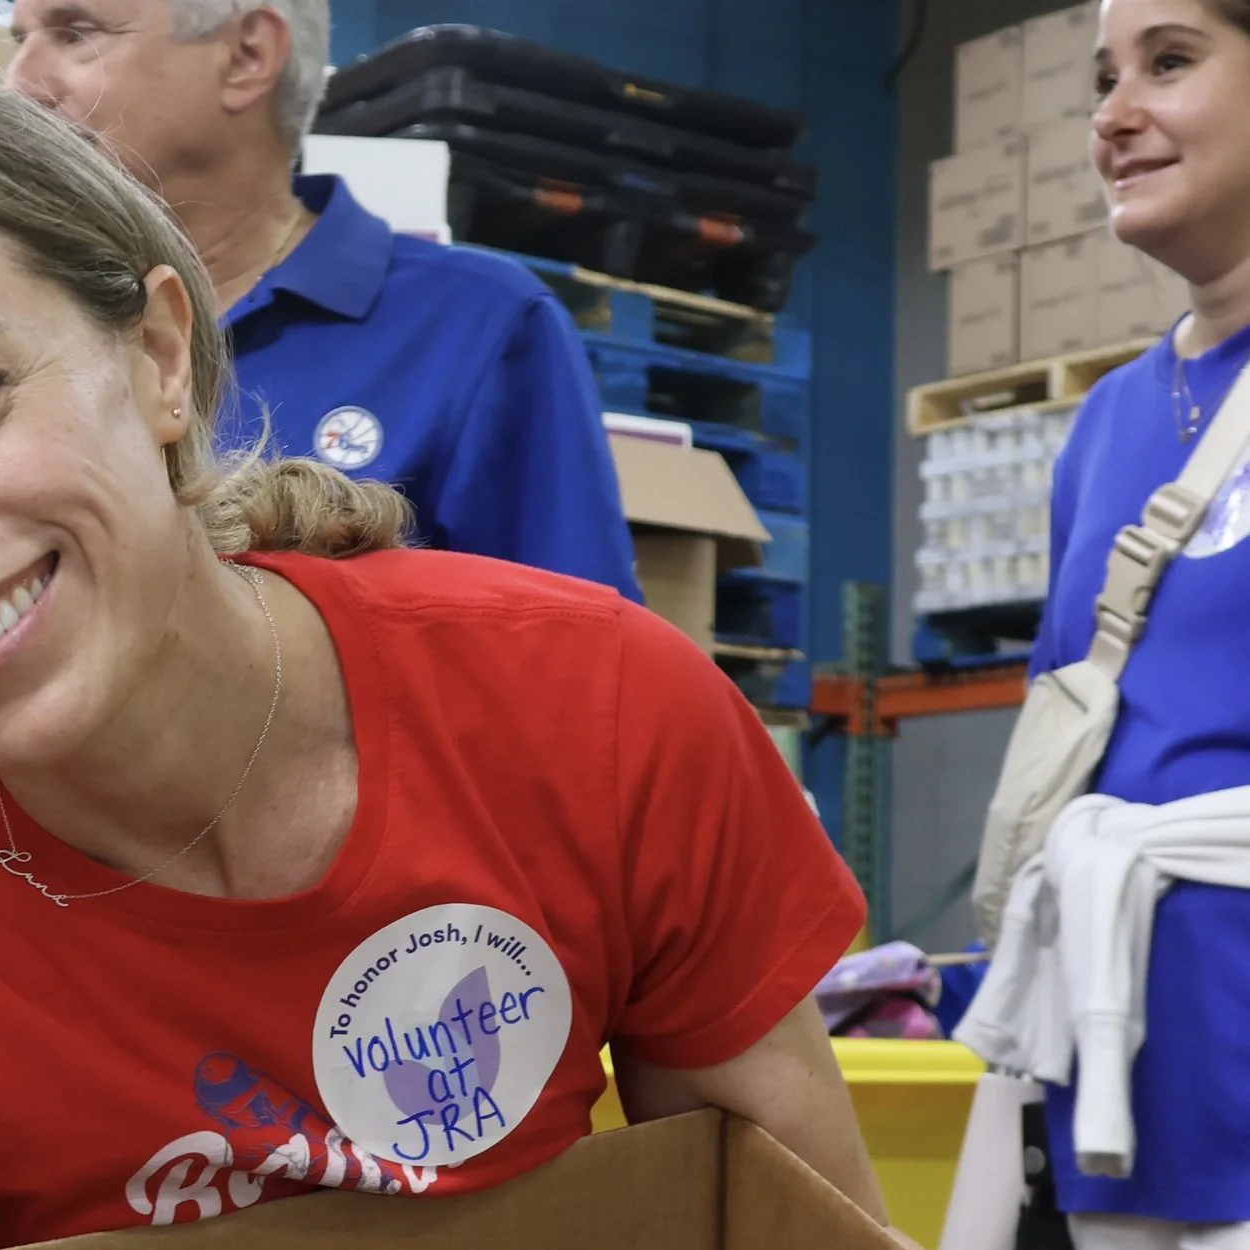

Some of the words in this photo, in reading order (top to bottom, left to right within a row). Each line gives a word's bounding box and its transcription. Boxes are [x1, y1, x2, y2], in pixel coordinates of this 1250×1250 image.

[405, 923, 468, 953] Josh,
[474, 925, 483, 943] I
[340, 948, 398, 1007] honor
[329, 1013, 352, 1039] To
[427, 1056, 475, 1103] at
[392, 1086, 506, 1161] JRA
